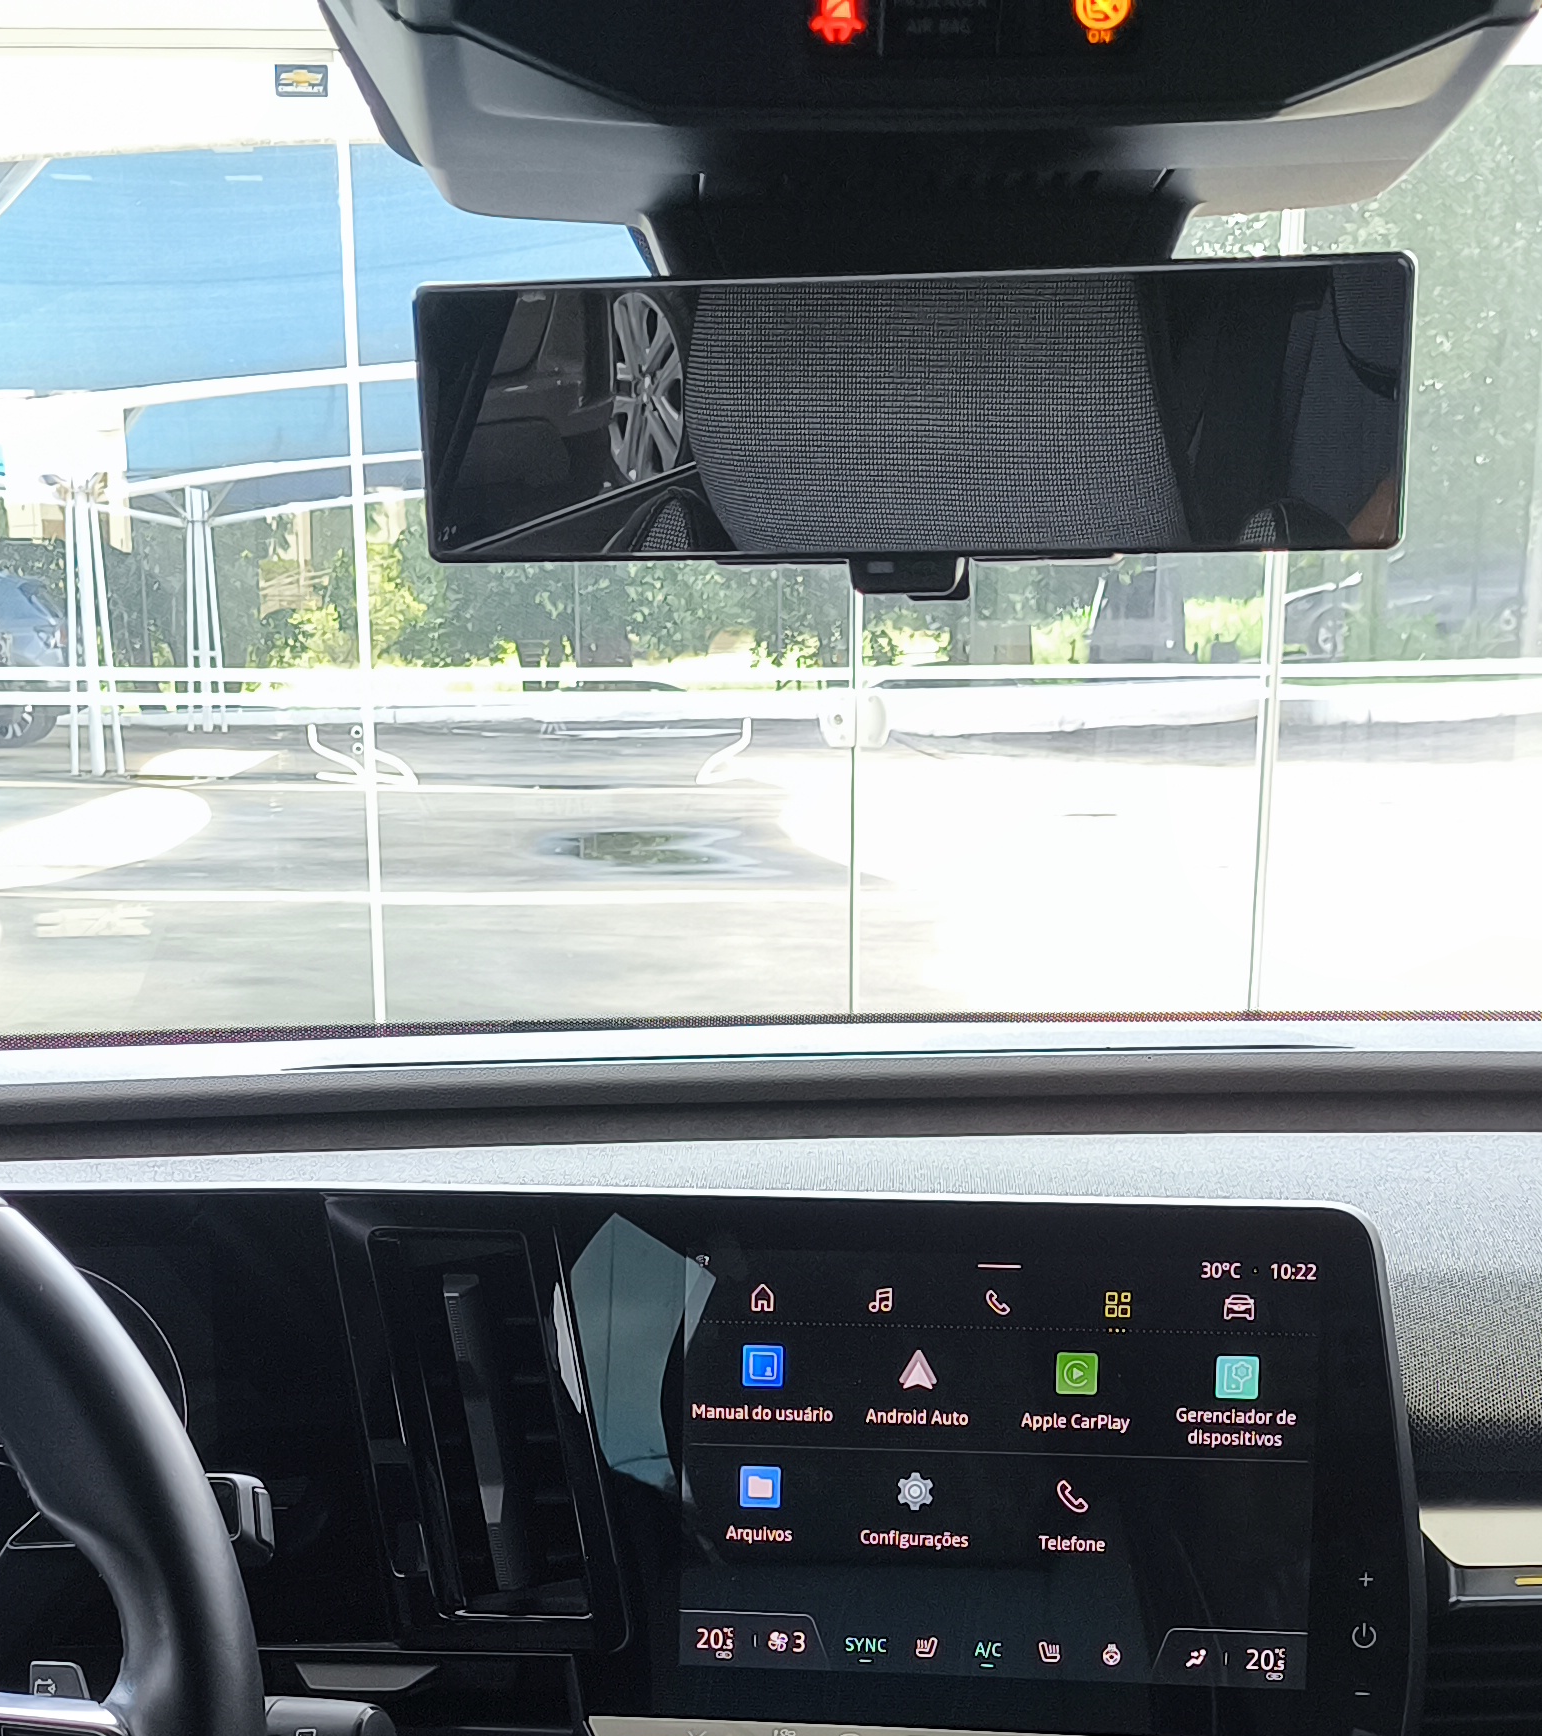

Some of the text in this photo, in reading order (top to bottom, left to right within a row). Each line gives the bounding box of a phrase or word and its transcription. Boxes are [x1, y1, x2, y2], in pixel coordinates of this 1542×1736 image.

[1270, 1263, 1317, 1281] 10:22
[692, 1404, 833, 1422] Manual do usuário
[866, 1408, 969, 1426] Android Auto
[1176, 1408, 1297, 1426] Gerenciador de
[1021, 1413, 1130, 1433] Apple CarPlay
[1187, 1429, 1283, 1448] dispositivos
[725, 1525, 793, 1544] Arquivos
[860, 1529, 969, 1550] Configurações
[1038, 1535, 1106, 1552] Telefone
[792, 1631, 806, 1653] 3
[845, 1637, 887, 1653] SYNC
[974, 1641, 1002, 1658] A/C
